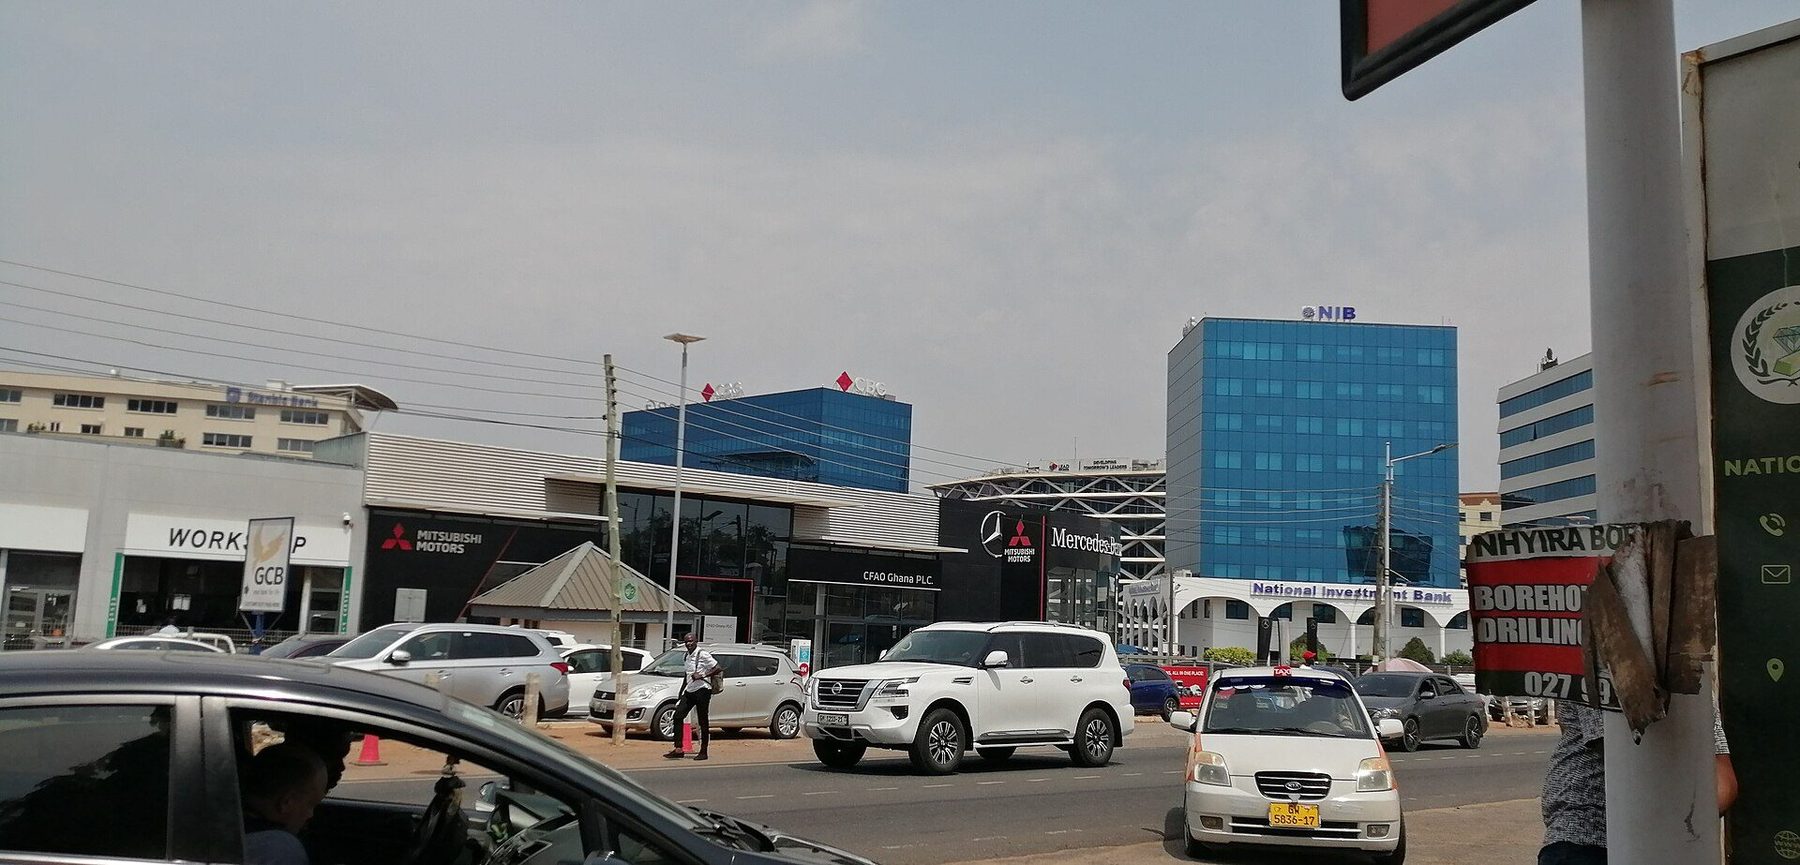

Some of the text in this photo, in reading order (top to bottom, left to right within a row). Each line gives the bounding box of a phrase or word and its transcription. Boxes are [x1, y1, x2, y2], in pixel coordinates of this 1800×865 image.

[1318, 305, 1356, 320] NIB
[854, 376, 887, 396] CBG
[417, 530, 482, 544] MITSUBISHI
[1474, 527, 1586, 558] NHYIRA
[416, 541, 465, 554] MOTORS
[1004, 548, 1036, 556] MITSUBISHI
[1007, 555, 1031, 563] MOTORS
[255, 566, 284, 585] GCB
[863, 571, 934, 585] CFAO Ghana PLC.
[1253, 582, 1317, 596] National
[1413, 589, 1452, 602] Bank
[1474, 584, 1587, 612] BOREHO
[1274, 668, 1291, 676] TAXI
[1524, 671, 1572, 699] 027
[1288, 803, 1300, 815] GW
[1274, 814, 1315, 826] 5836-17
